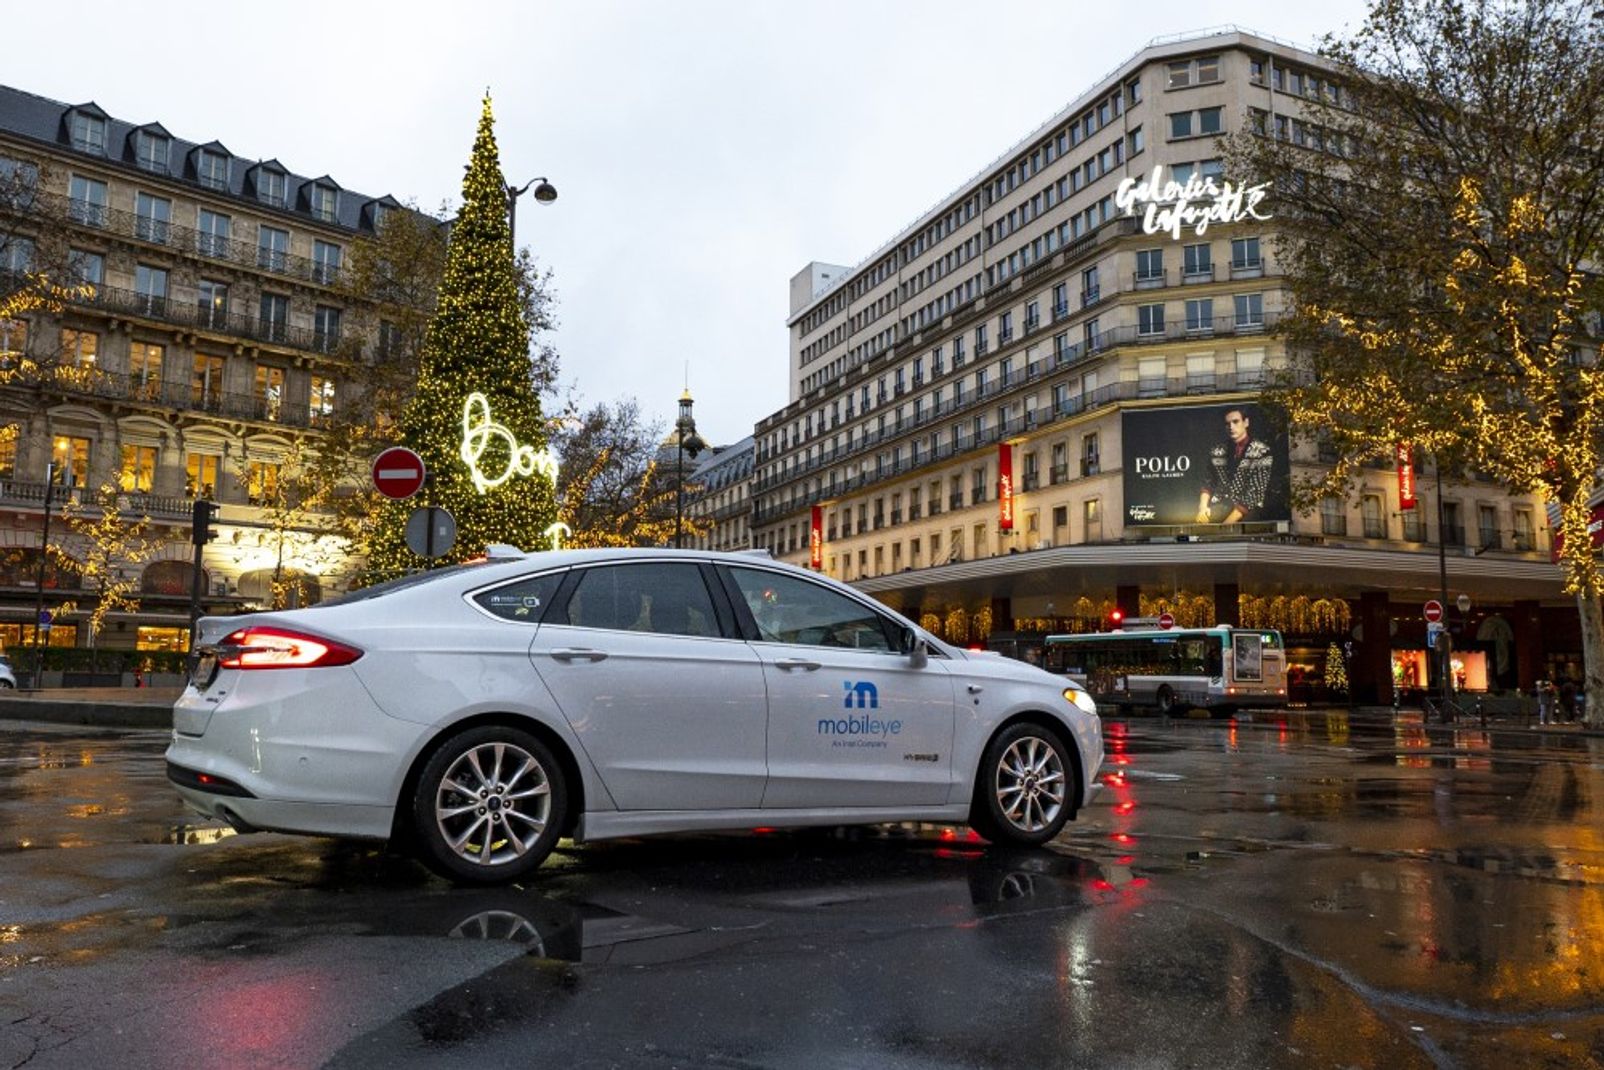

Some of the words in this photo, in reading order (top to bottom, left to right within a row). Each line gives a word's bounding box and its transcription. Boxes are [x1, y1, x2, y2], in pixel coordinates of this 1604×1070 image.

[1115, 165, 1219, 215] Galeries
[1143, 180, 1273, 239] Lafayette
[1135, 456, 1190, 473] POLO
[818, 715, 901, 738] mobileye
